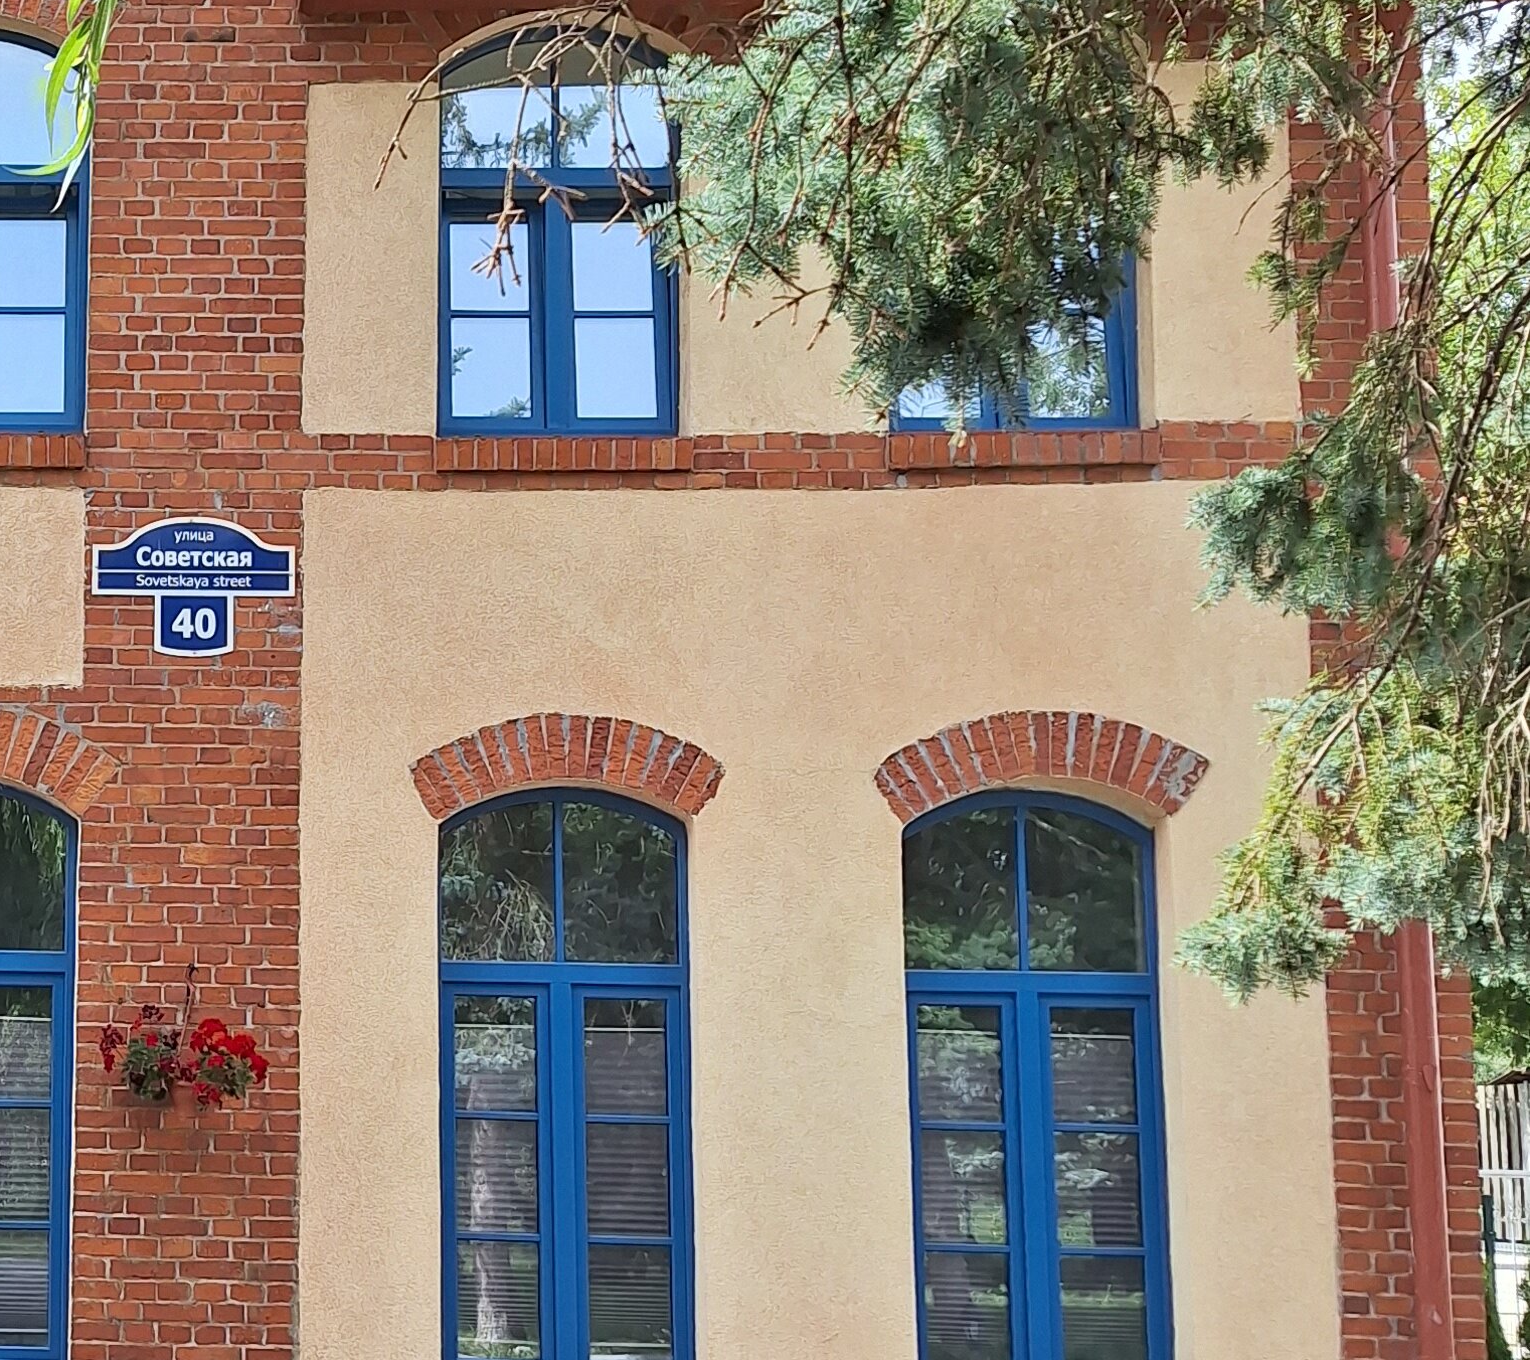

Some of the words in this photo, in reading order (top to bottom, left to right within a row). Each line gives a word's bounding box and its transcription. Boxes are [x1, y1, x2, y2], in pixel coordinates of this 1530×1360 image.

[174, 529, 215, 544] улица
[135, 546, 253, 568] Советская
[136, 574, 209, 590] Sovetskaya
[212, 575, 252, 588] street
[171, 607, 217, 640] 40
